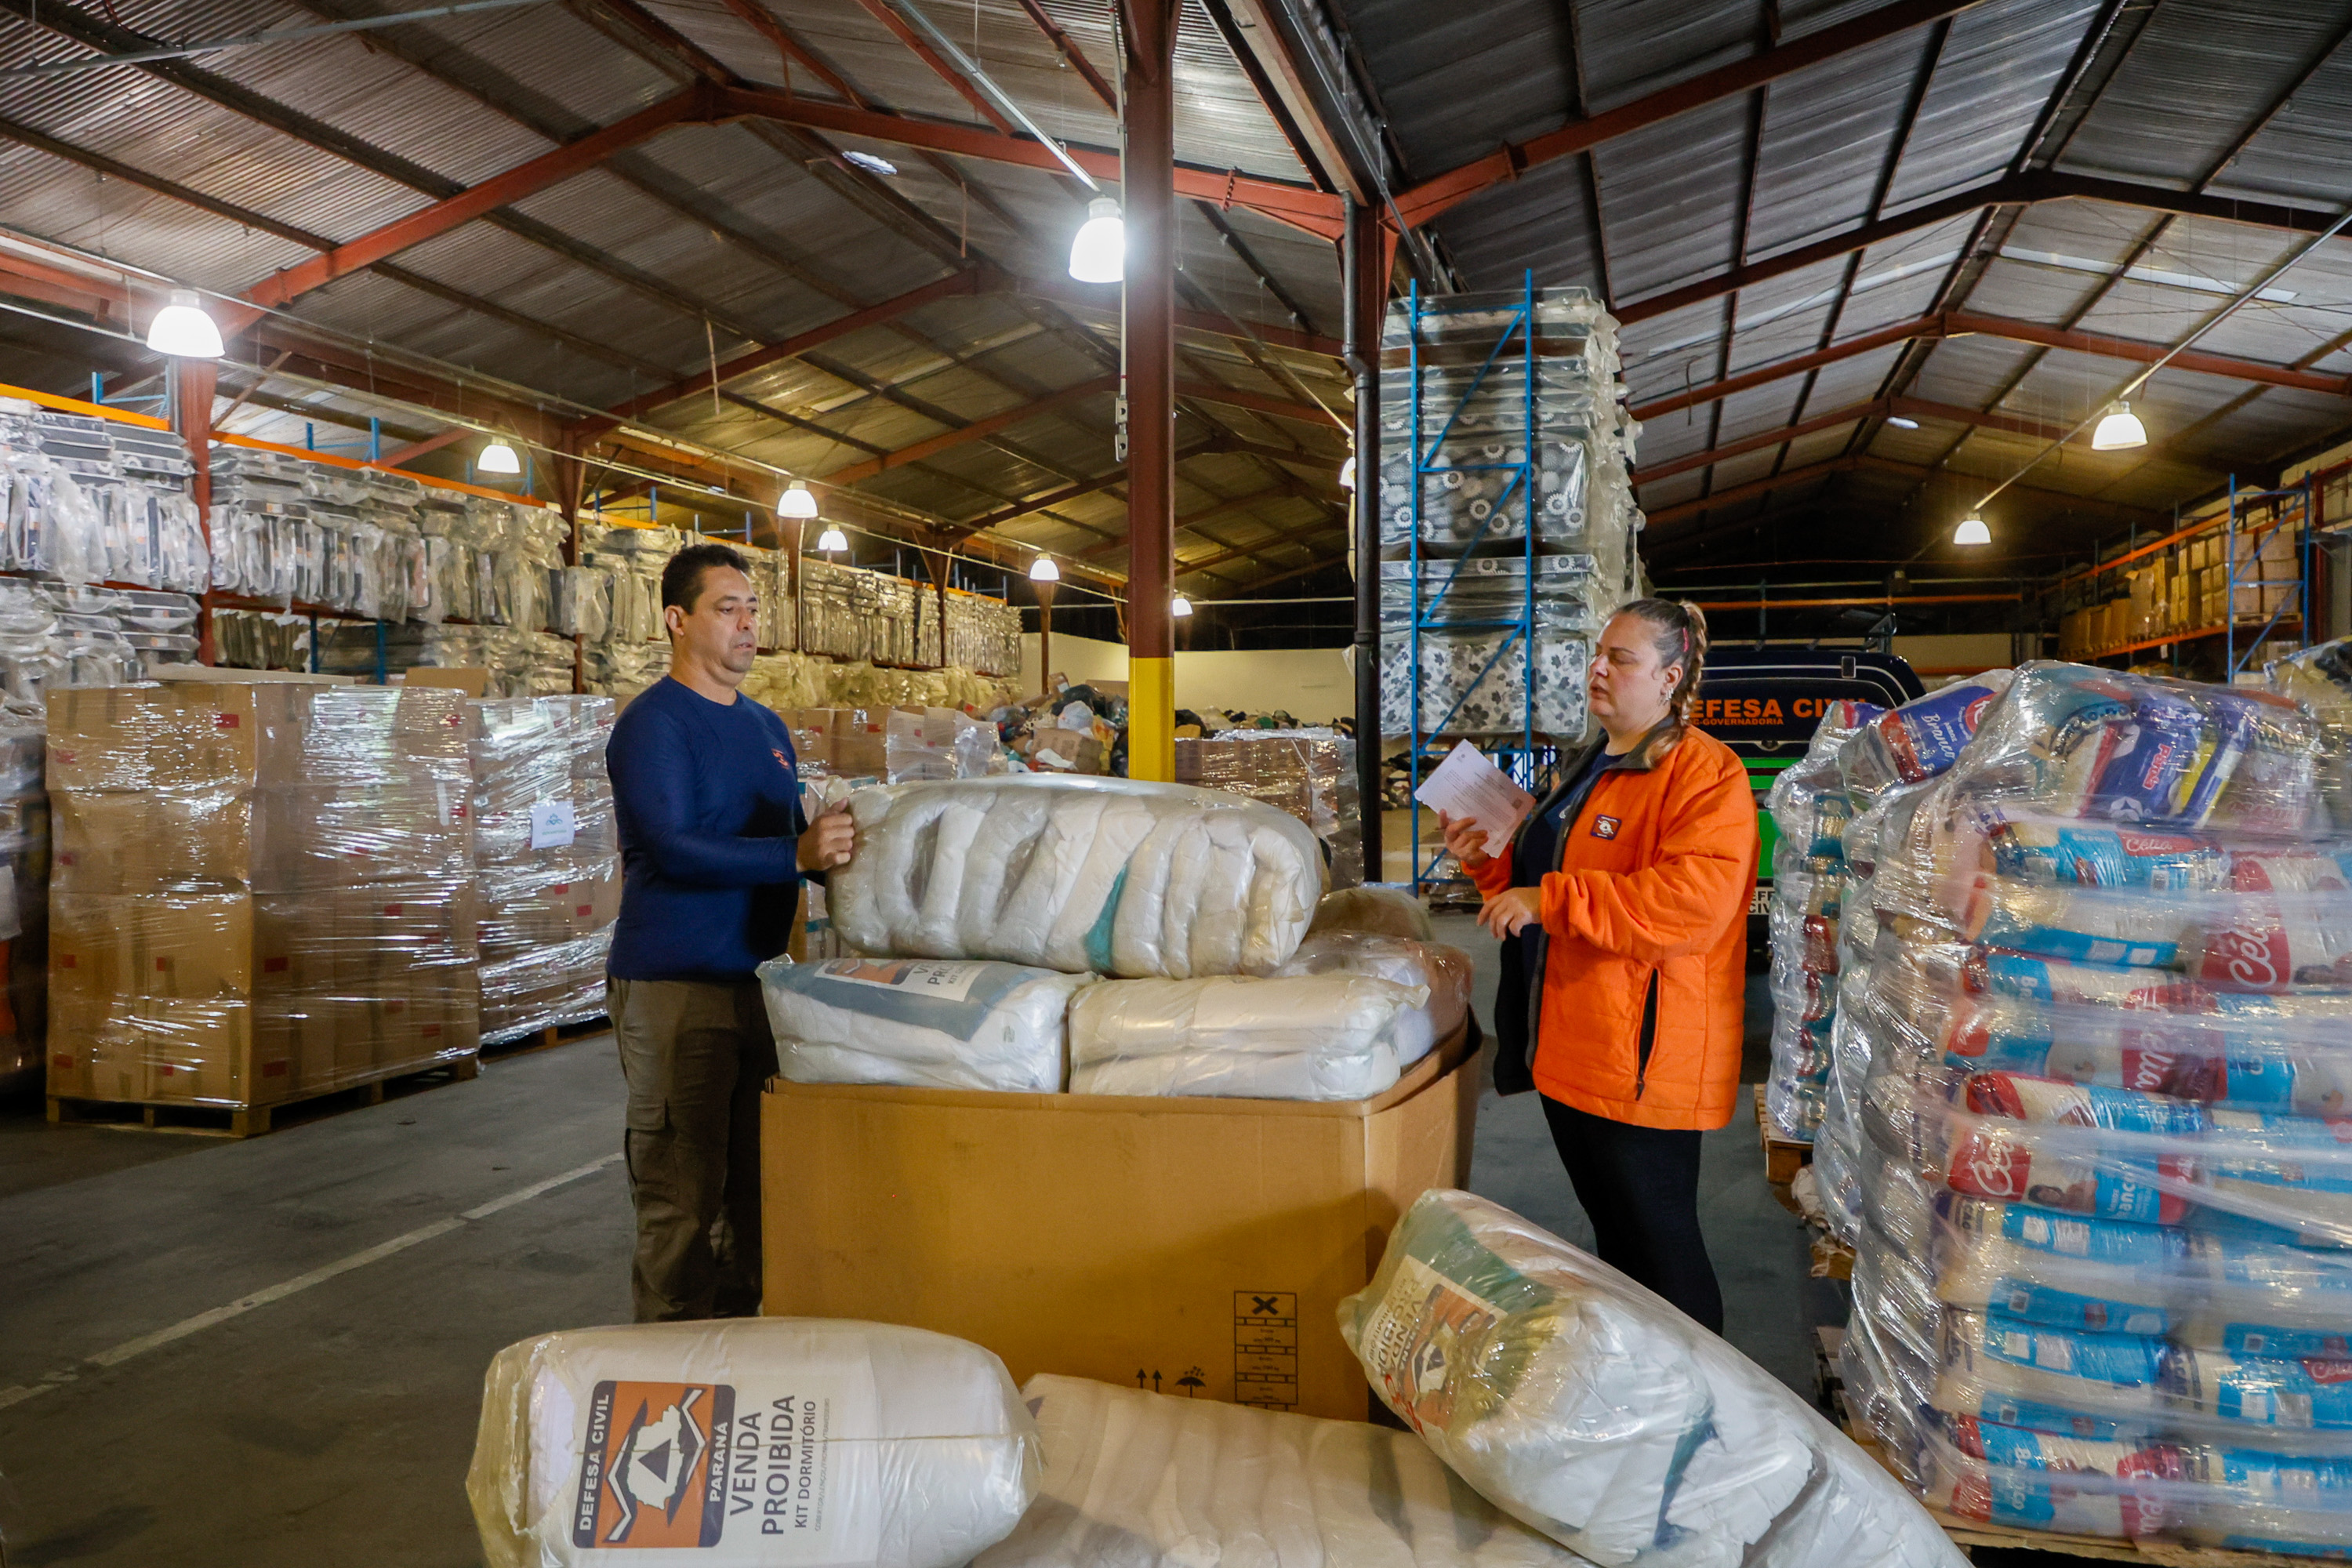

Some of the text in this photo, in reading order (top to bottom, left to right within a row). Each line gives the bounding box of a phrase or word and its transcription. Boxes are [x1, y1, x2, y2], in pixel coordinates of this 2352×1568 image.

[1690, 699, 1784, 718] EFESA
[1921, 713, 1955, 760] Branco
[579, 1395, 610, 1530] DEFESA CIVIL
[709, 1421, 728, 1502] PARANÁ
[729, 1412, 762, 1516] VENDA
[761, 1396, 795, 1534] PROIBIDA
[794, 1400, 816, 1528] KIT DORMITÓRIO
